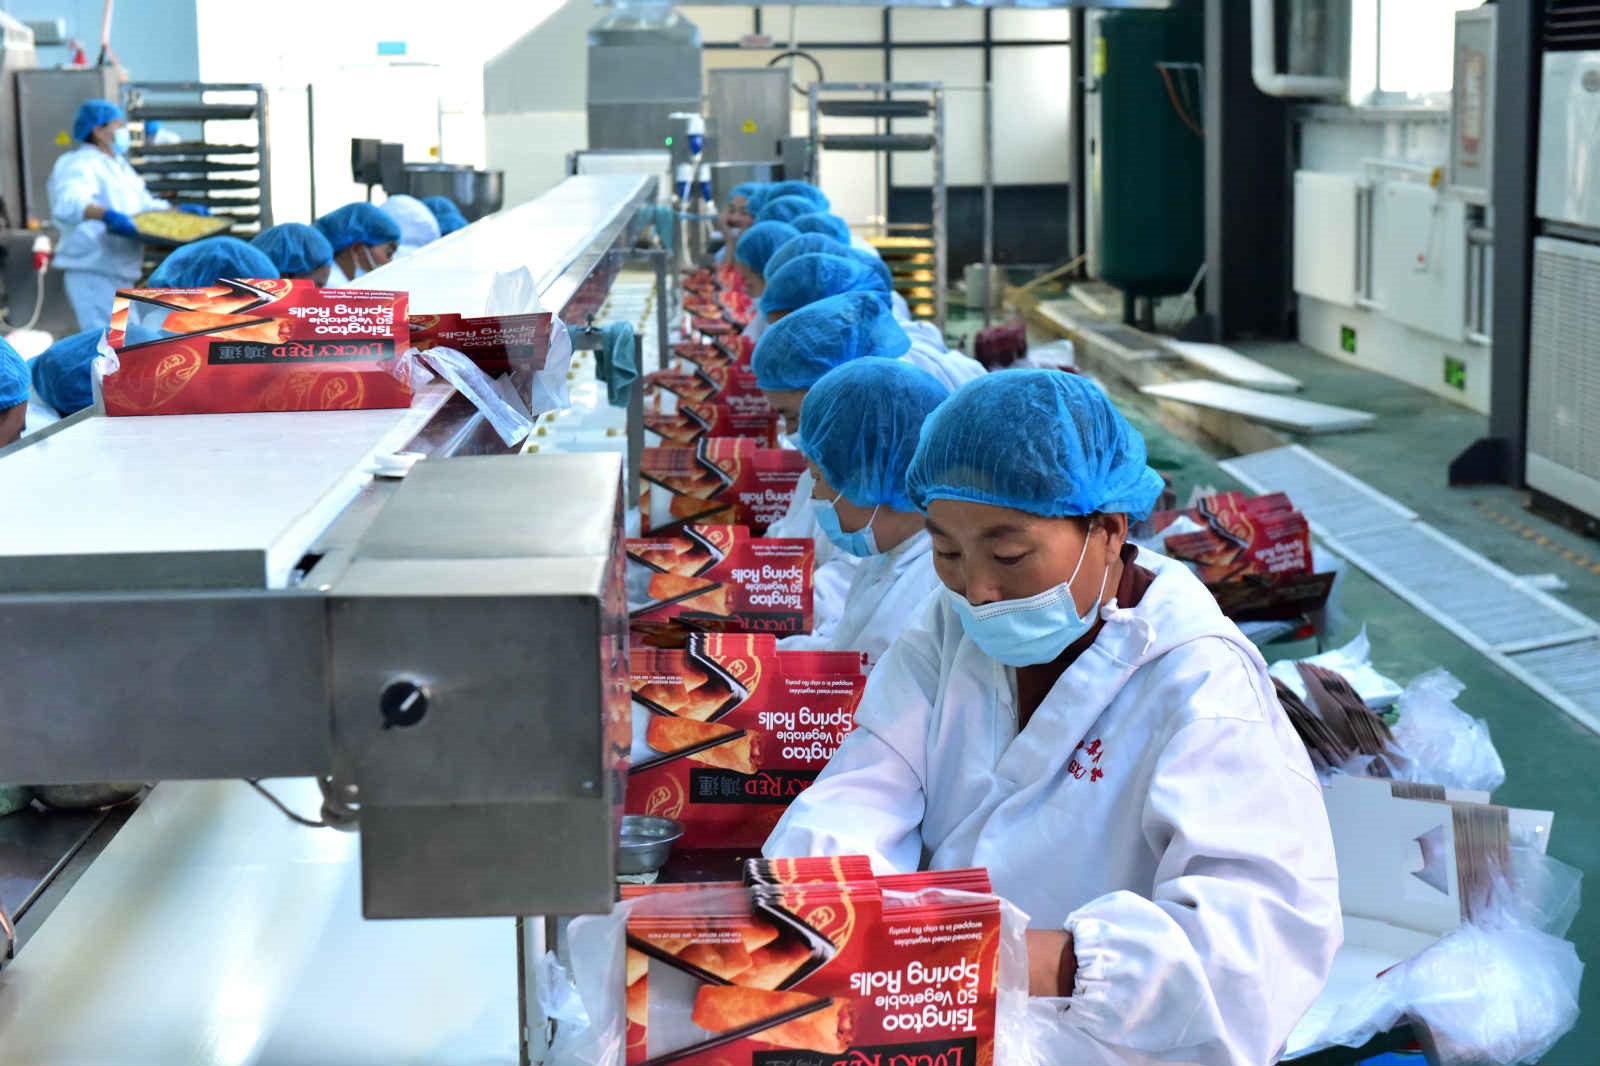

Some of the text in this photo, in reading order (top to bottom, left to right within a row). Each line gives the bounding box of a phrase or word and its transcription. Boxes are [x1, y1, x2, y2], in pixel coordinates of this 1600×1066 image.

[288, 304, 394, 318] Spring Rolls
[308, 317, 394, 325] 50 Vegetable
[315, 322, 394, 337] Tsingtao
[271, 342, 385, 358] LUCKY RED
[731, 565, 804, 584] Spring Rolls
[749, 591, 803, 610] Tsingtao
[758, 706, 853, 732] Spring Rolls
[776, 729, 833, 744] Vegetable
[782, 741, 838, 763] ngtao
[744, 772, 782, 797] RED
[850, 957, 980, 996] Spring Rolls
[875, 987, 978, 1011] 50 Vegetable
[882, 1004, 977, 1034] Tsingtao
